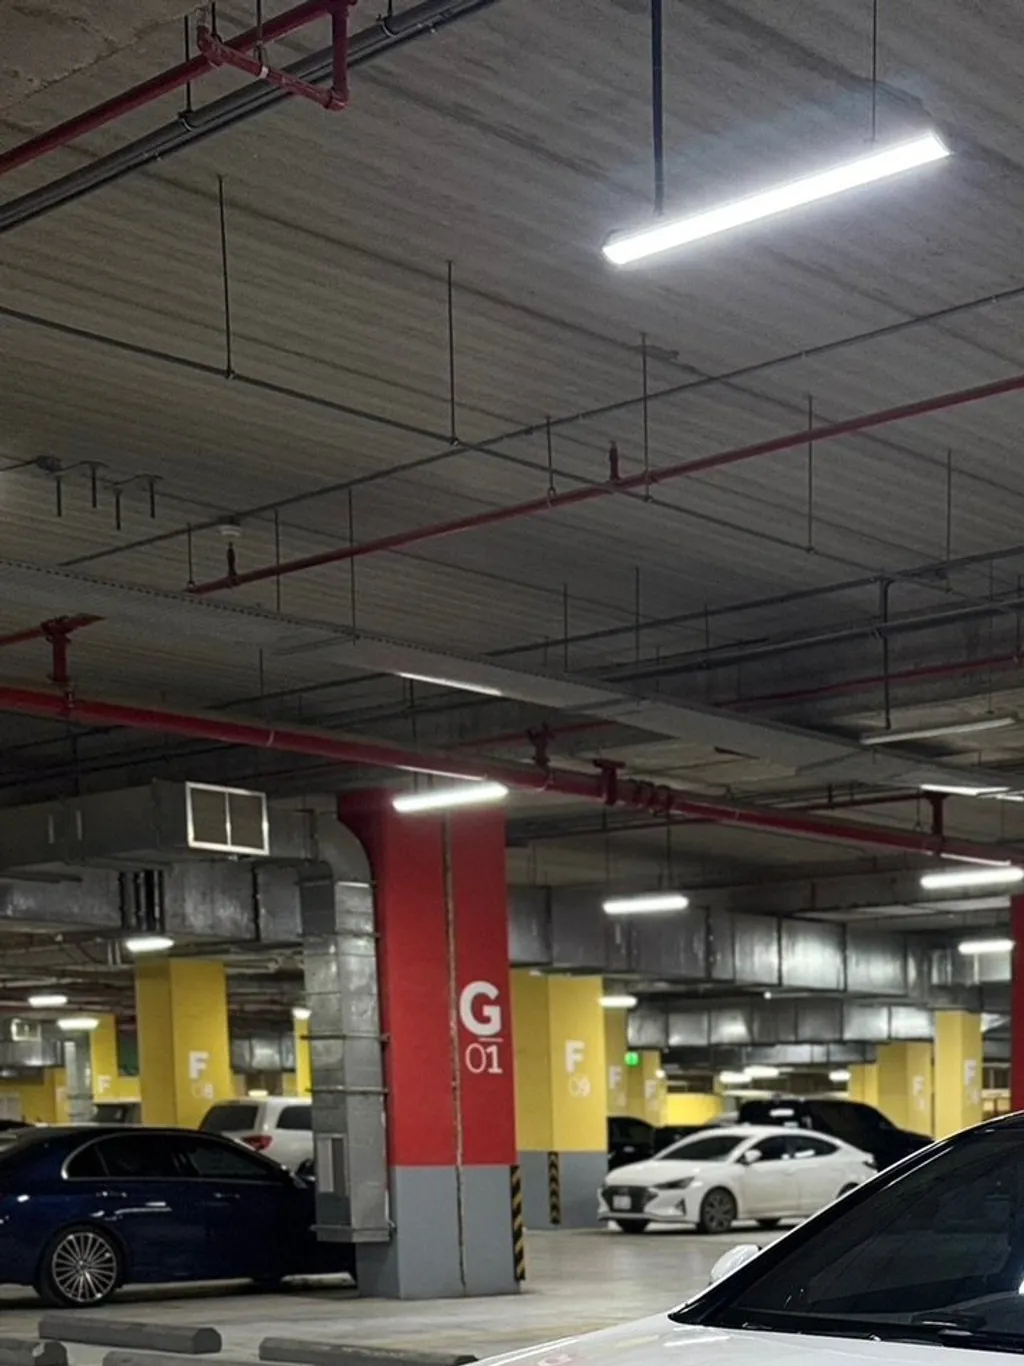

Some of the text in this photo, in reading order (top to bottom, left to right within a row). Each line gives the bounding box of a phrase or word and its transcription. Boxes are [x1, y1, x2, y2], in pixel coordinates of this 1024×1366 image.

[459, 980, 502, 1037] G
[188, 1050, 210, 1080] F
[465, 1042, 503, 1074] 01
[565, 1039, 586, 1073] F
